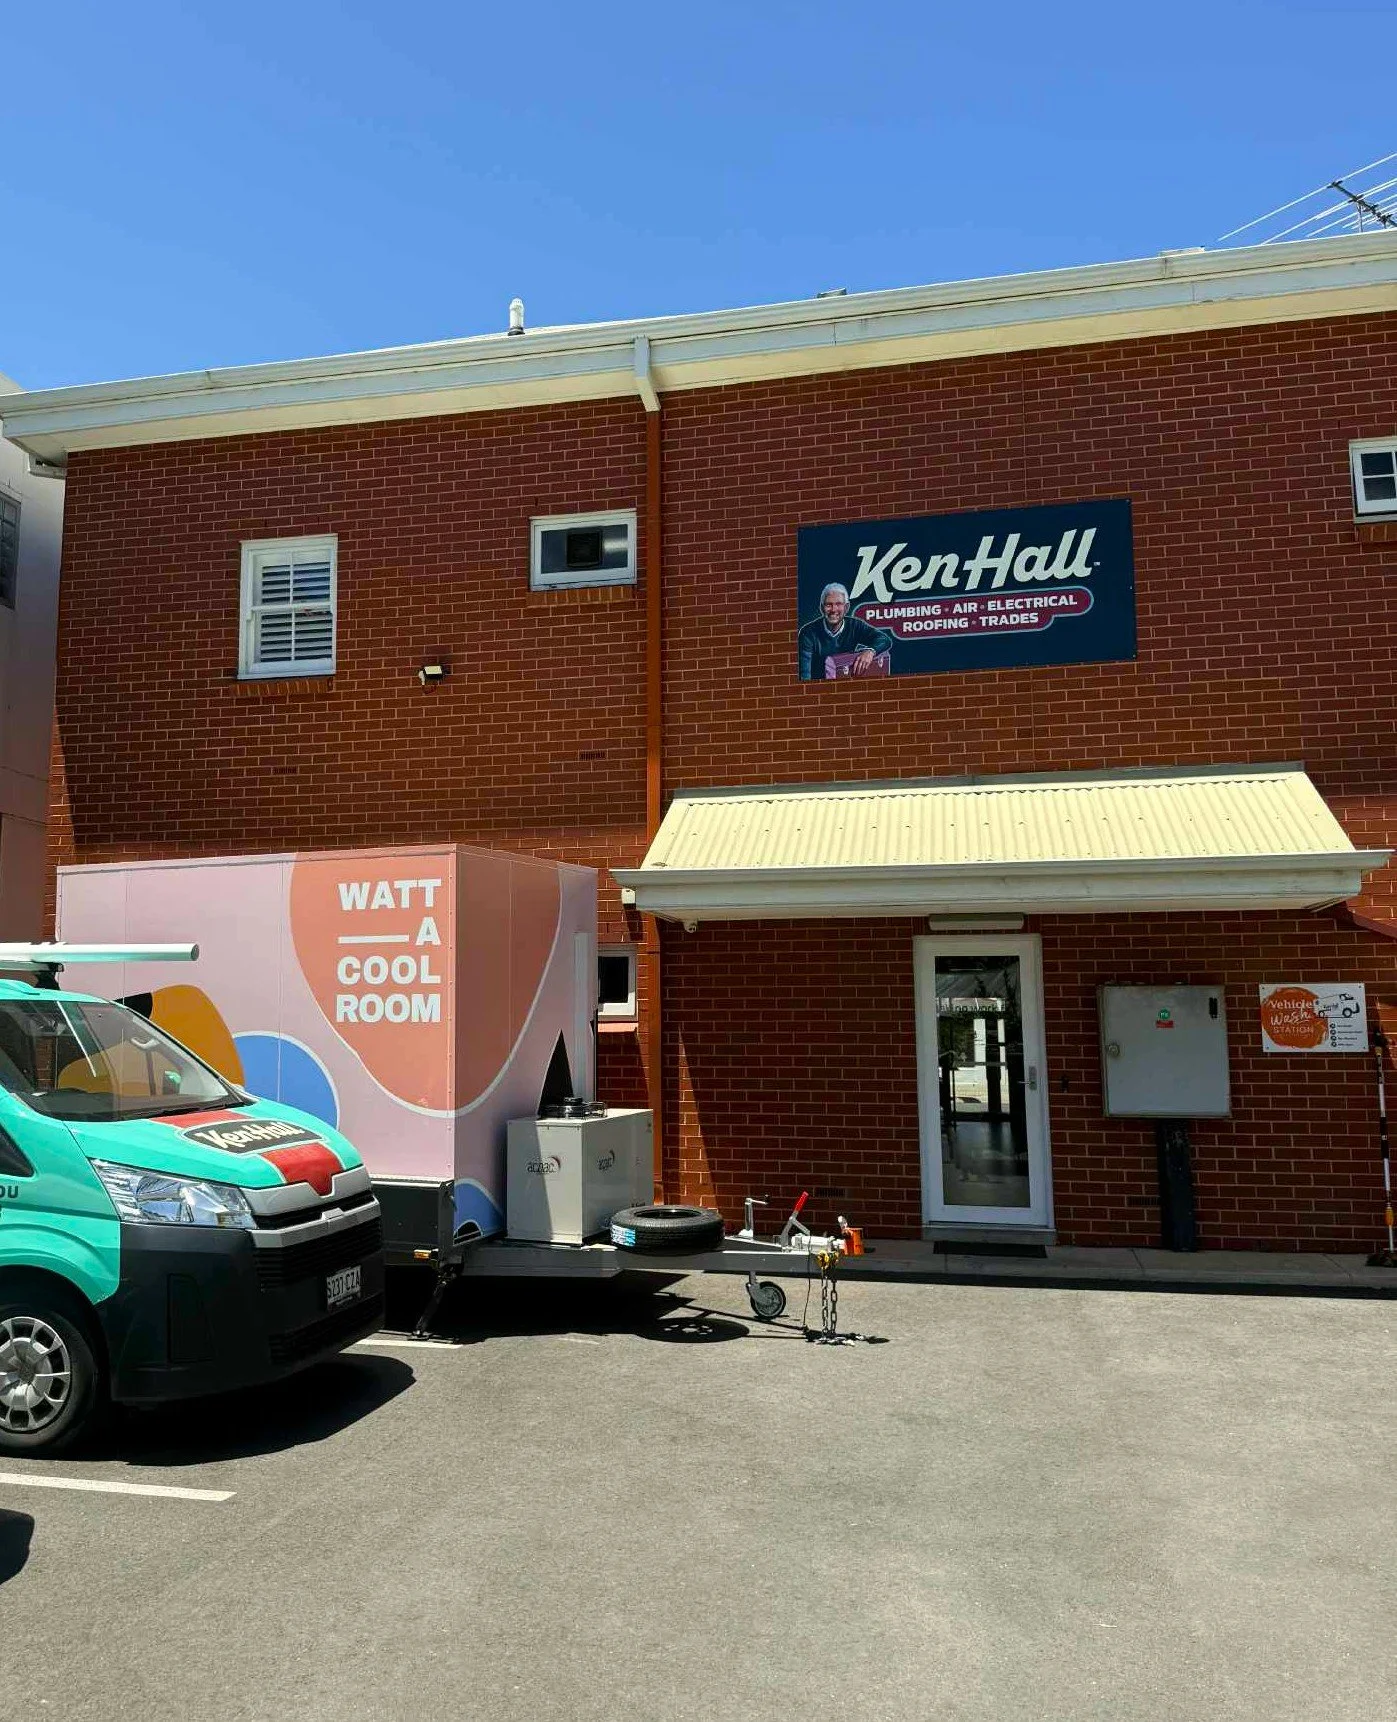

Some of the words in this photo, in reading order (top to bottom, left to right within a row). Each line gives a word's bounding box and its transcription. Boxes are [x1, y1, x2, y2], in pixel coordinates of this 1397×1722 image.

[865, 604, 942, 621] PLUMBING
[952, 601, 978, 614] AIR
[987, 594, 1078, 612] ELECTRICAL
[902, 617, 969, 633] ROOFING
[979, 612, 1039, 627] TRADES
[338, 878, 442, 911] WATT
[415, 916, 442, 946] A
[337, 955, 442, 985] COOL
[336, 993, 442, 1023] ROOM
[1269, 998, 1313, 1009] Vehicle
[1270, 1010, 1312, 1026] Wash
[1273, 1025, 1314, 1034] STATION
